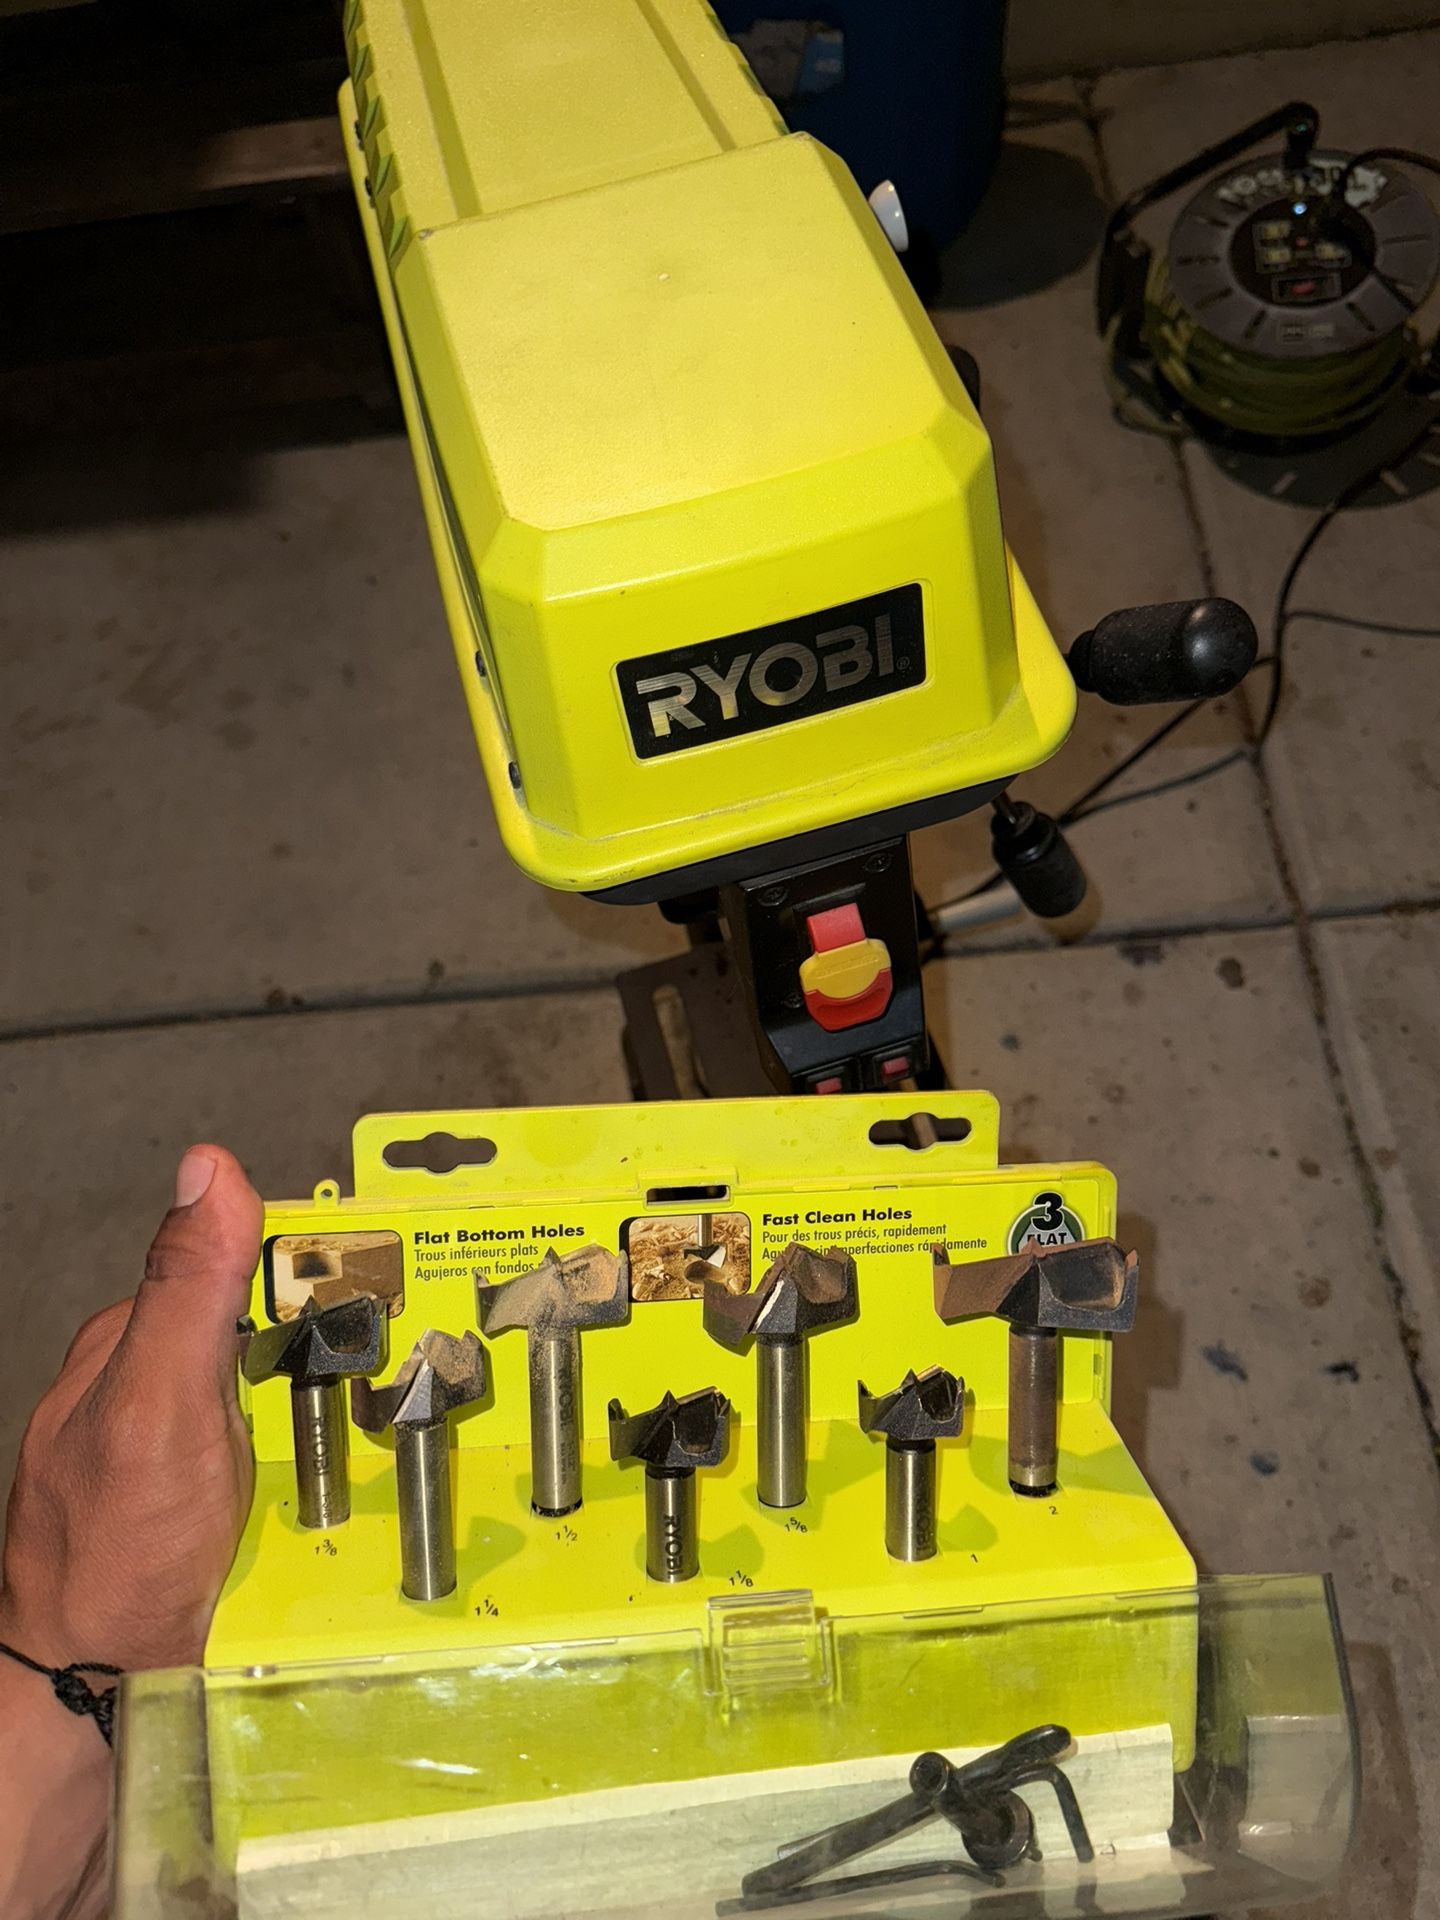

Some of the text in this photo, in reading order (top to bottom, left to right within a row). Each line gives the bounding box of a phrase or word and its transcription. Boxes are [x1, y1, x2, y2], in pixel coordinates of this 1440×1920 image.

[635, 612, 895, 738] RYOBI
[763, 1207, 912, 1226] Fast Clean Holes
[1032, 1191, 1064, 1231] 3
[414, 1223, 585, 1245] Flat Bottom Holes
[762, 1223, 947, 1243] Pour des trous précis, rapidement
[414, 1243, 539, 1262] Trous inférieurs plats
[917, 1237, 988, 1253] rádamente
[414, 1266, 468, 1281] Agujeros
[495, 1260, 535, 1275] fondos
[1048, 1505, 1059, 1515] 2
[664, 1513, 684, 1577] RYOBI
